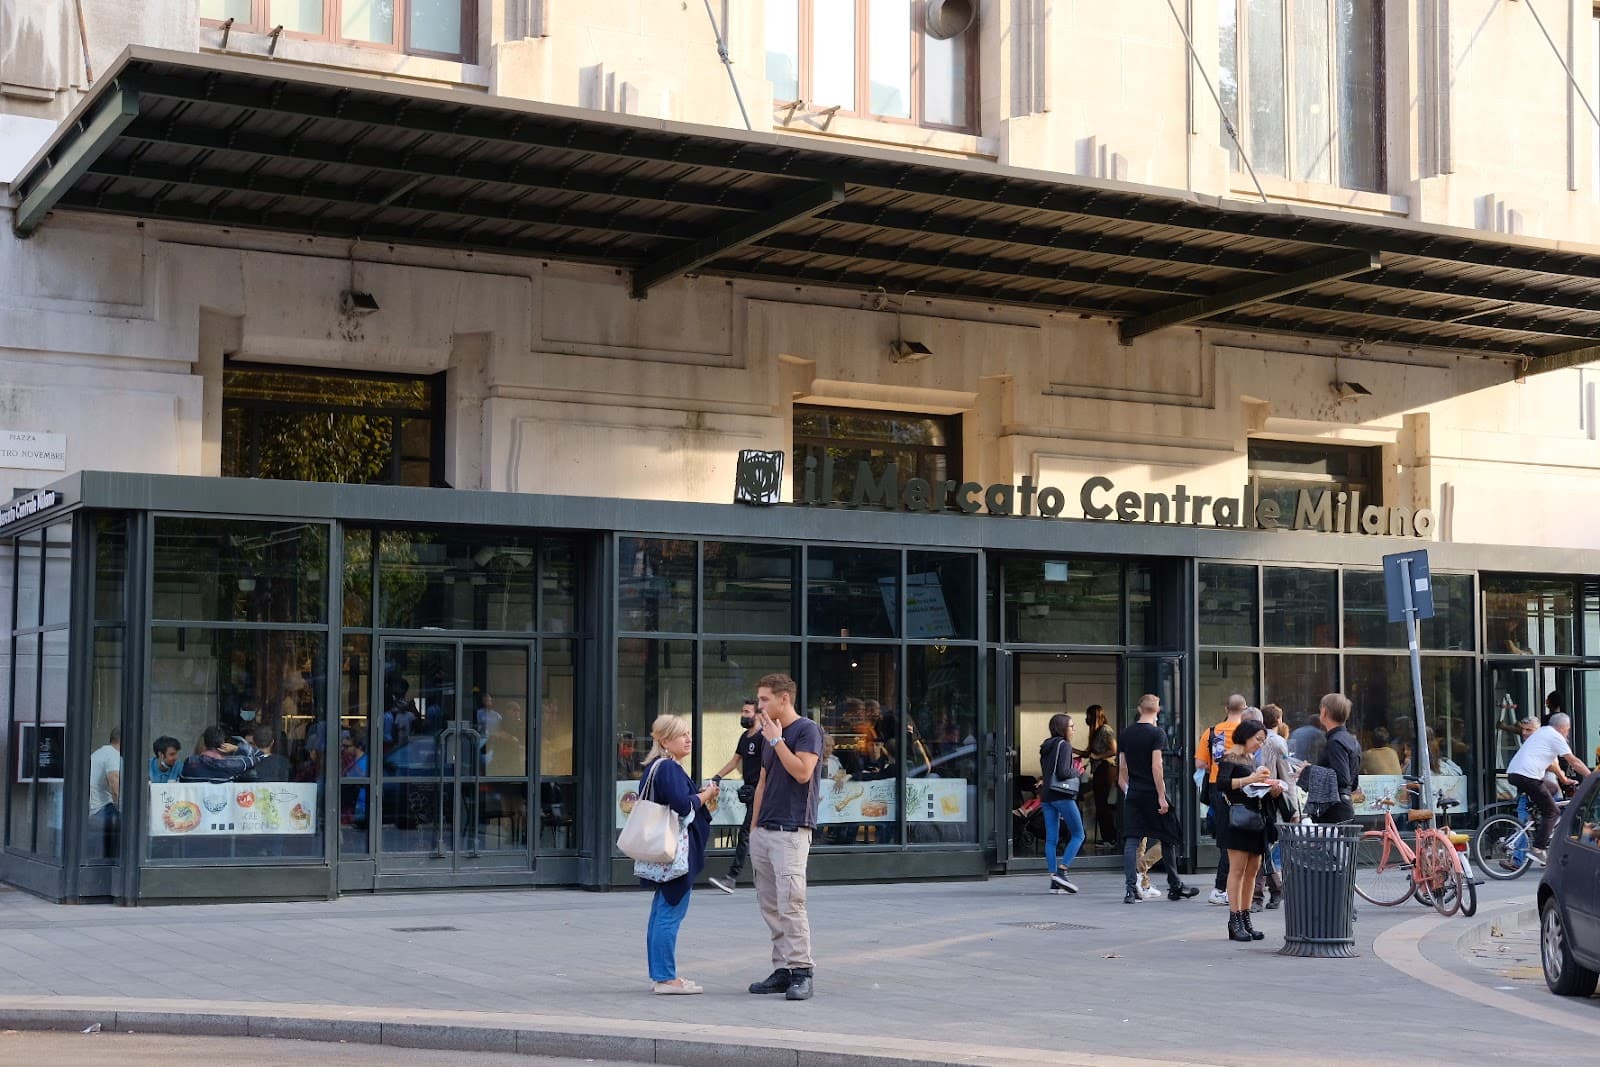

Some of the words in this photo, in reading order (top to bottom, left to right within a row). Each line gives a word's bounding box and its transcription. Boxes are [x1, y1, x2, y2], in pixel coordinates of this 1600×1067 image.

[21, 449, 65, 460] NOVEMBRE
[804, 453, 835, 503] il
[853, 461, 1065, 515] Mercato
[1080, 476, 1280, 528] Centrale
[1294, 488, 1435, 536] Milano
